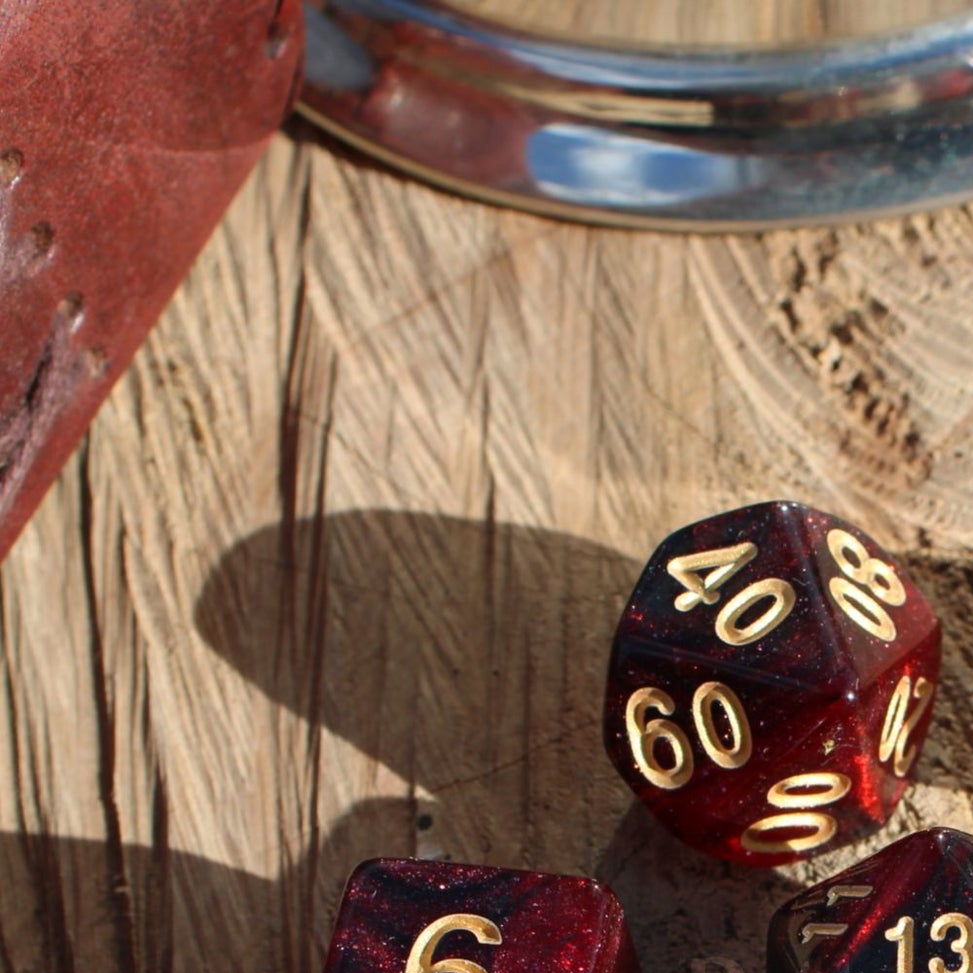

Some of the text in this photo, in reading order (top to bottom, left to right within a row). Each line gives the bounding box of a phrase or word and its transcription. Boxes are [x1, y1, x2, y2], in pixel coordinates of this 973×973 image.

[667, 542, 796, 645] 40
[827, 529, 906, 641] 80
[626, 682, 752, 789] 60
[741, 772, 851, 852] 00
